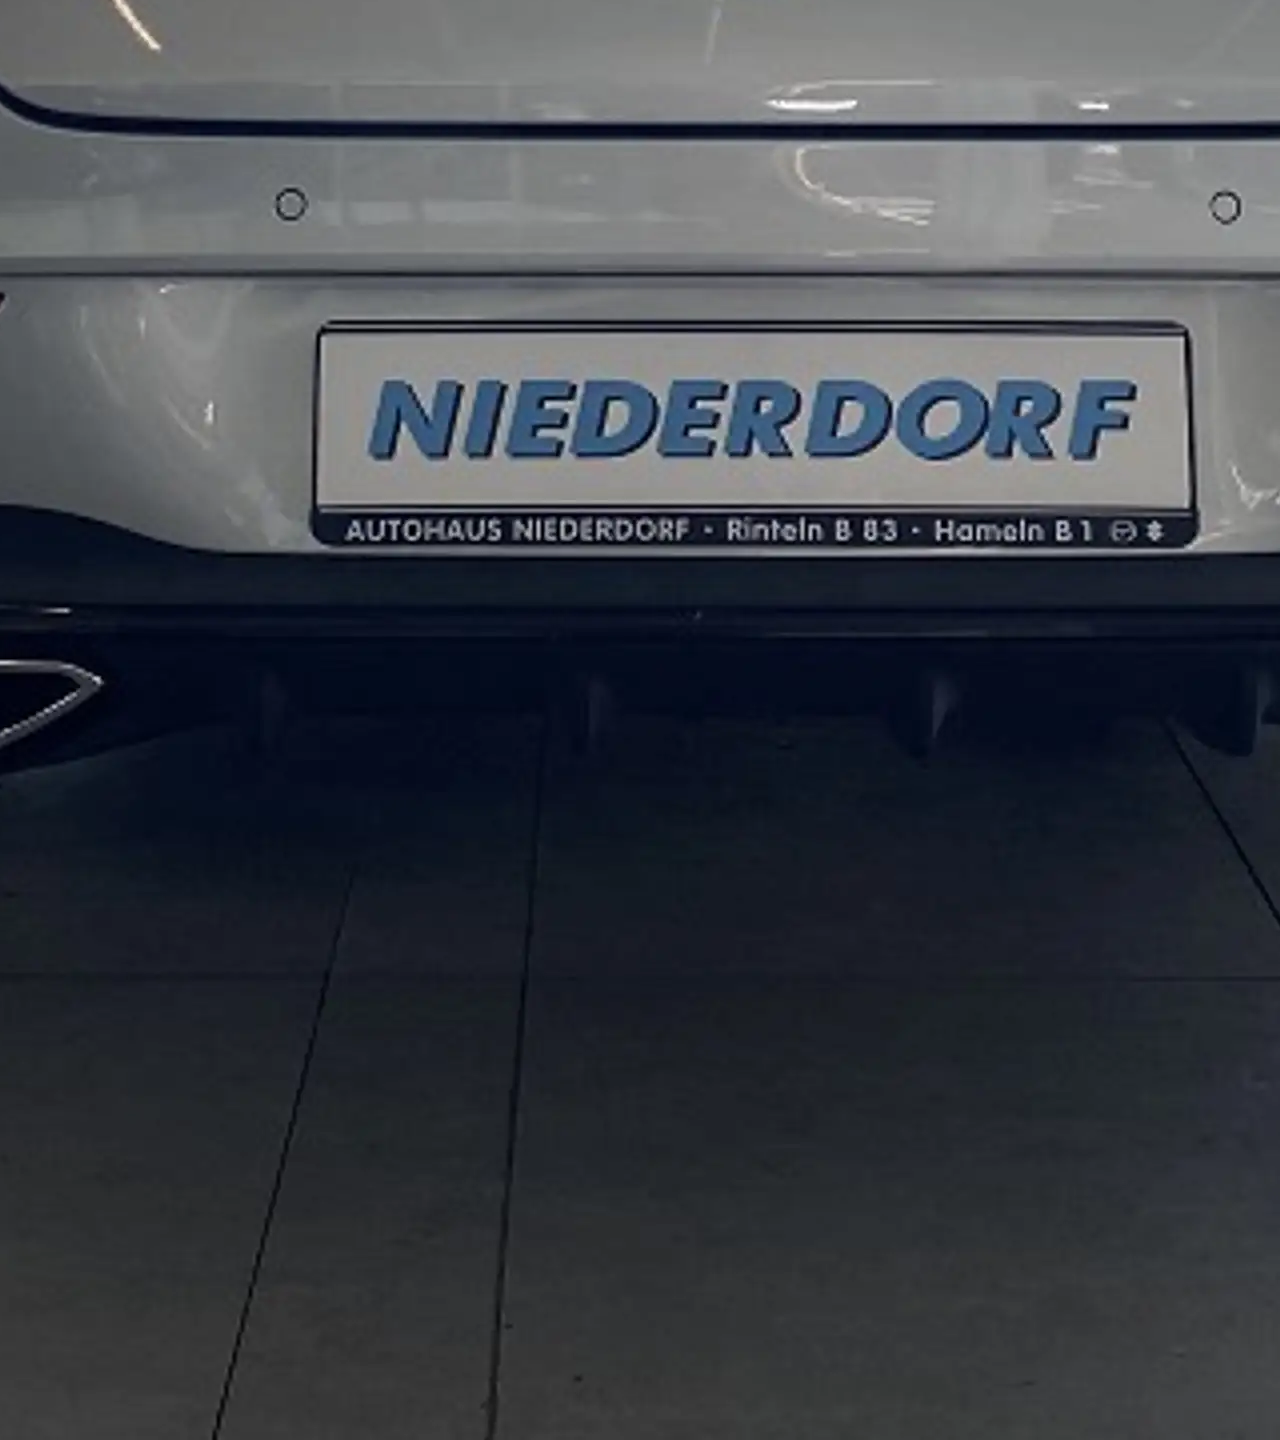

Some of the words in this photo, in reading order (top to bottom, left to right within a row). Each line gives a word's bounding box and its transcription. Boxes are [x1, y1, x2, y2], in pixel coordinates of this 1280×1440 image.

[368, 378, 1137, 461] NIEDERDORF
[344, 517, 502, 543] AUTOHAUS
[512, 517, 691, 543] NIEDERDORF
[726, 515, 825, 543] Rinteln
[834, 517, 854, 543] B
[862, 517, 899, 543] 83
[933, 518, 1046, 544] Hameln
[1054, 518, 1074, 544] B
[1080, 518, 1093, 544] 1
